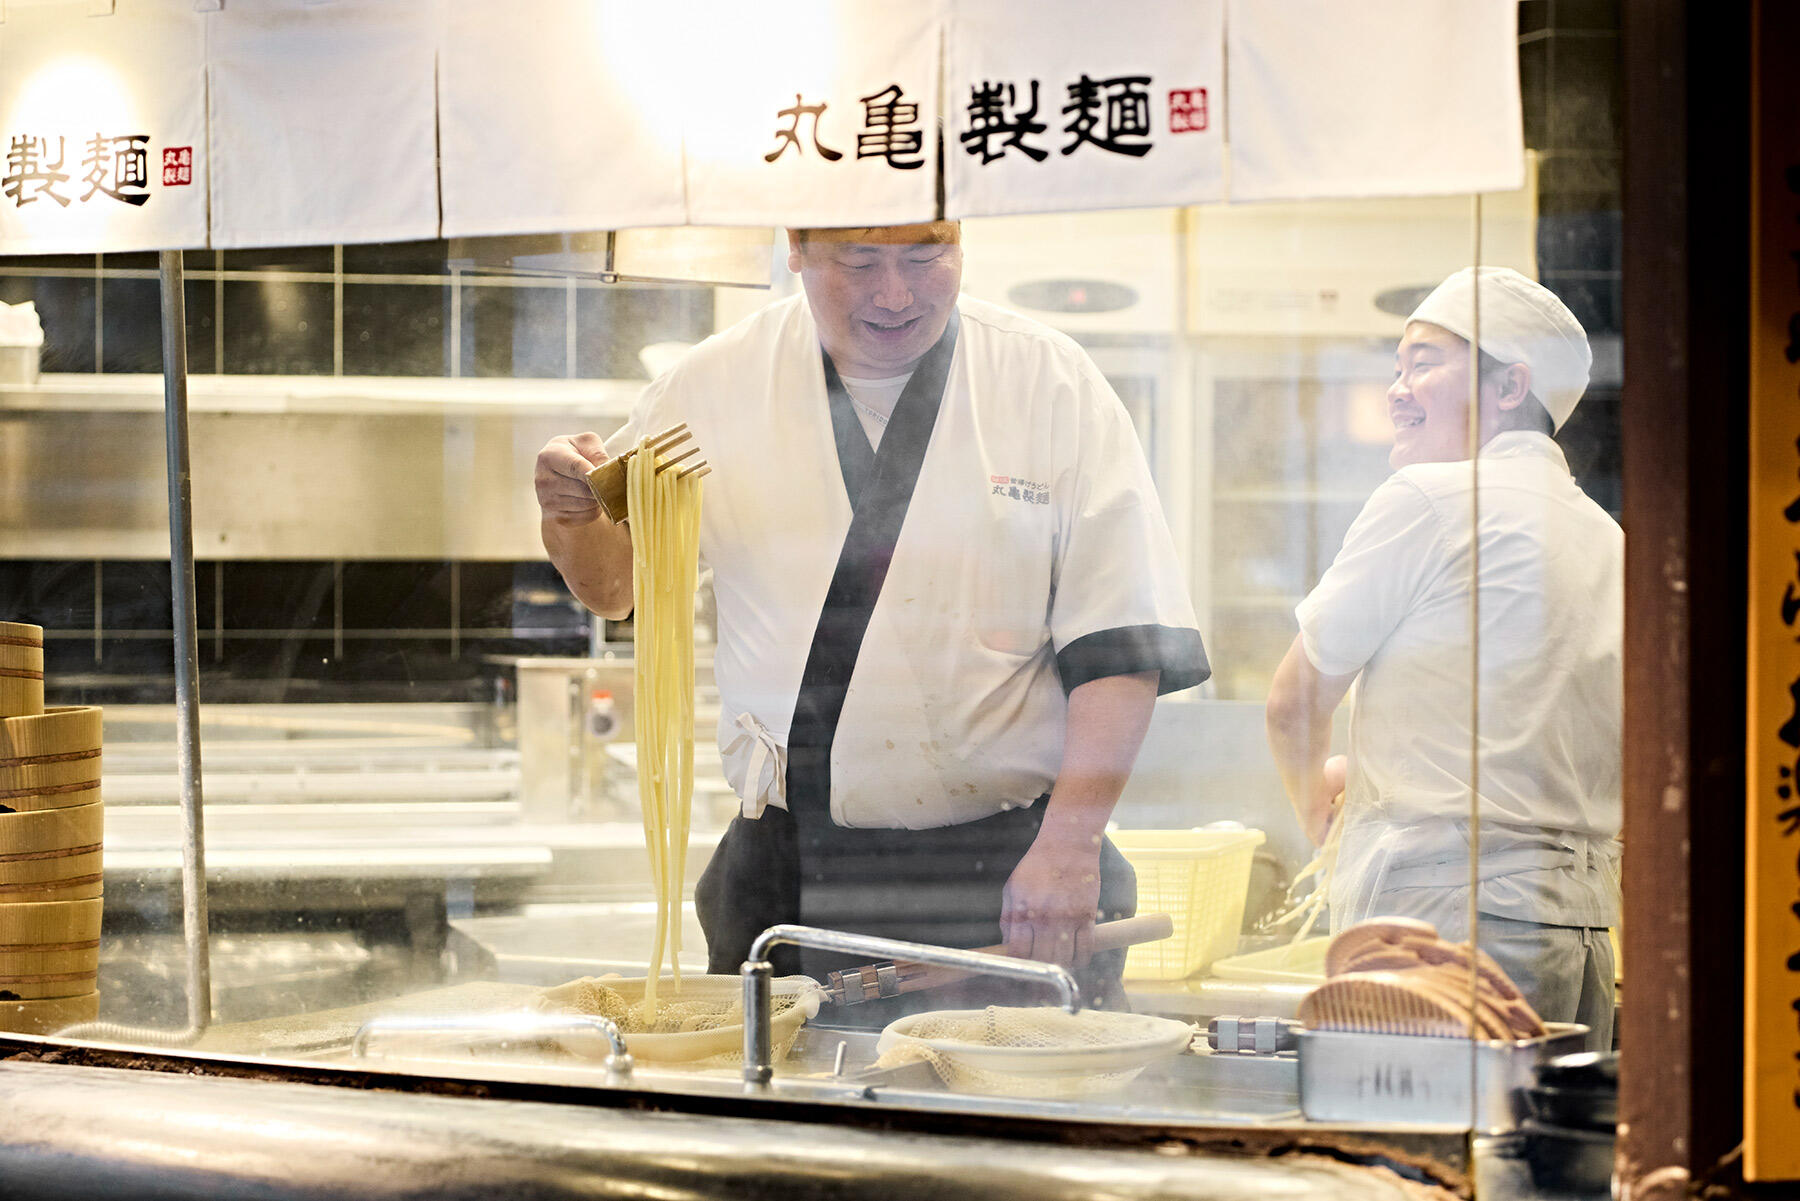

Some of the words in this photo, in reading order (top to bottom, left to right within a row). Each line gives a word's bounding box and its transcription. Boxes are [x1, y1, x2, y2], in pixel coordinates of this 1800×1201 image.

[764, 74, 1153, 169] 丸亀製麺
[1, 132, 151, 208] 製麺
